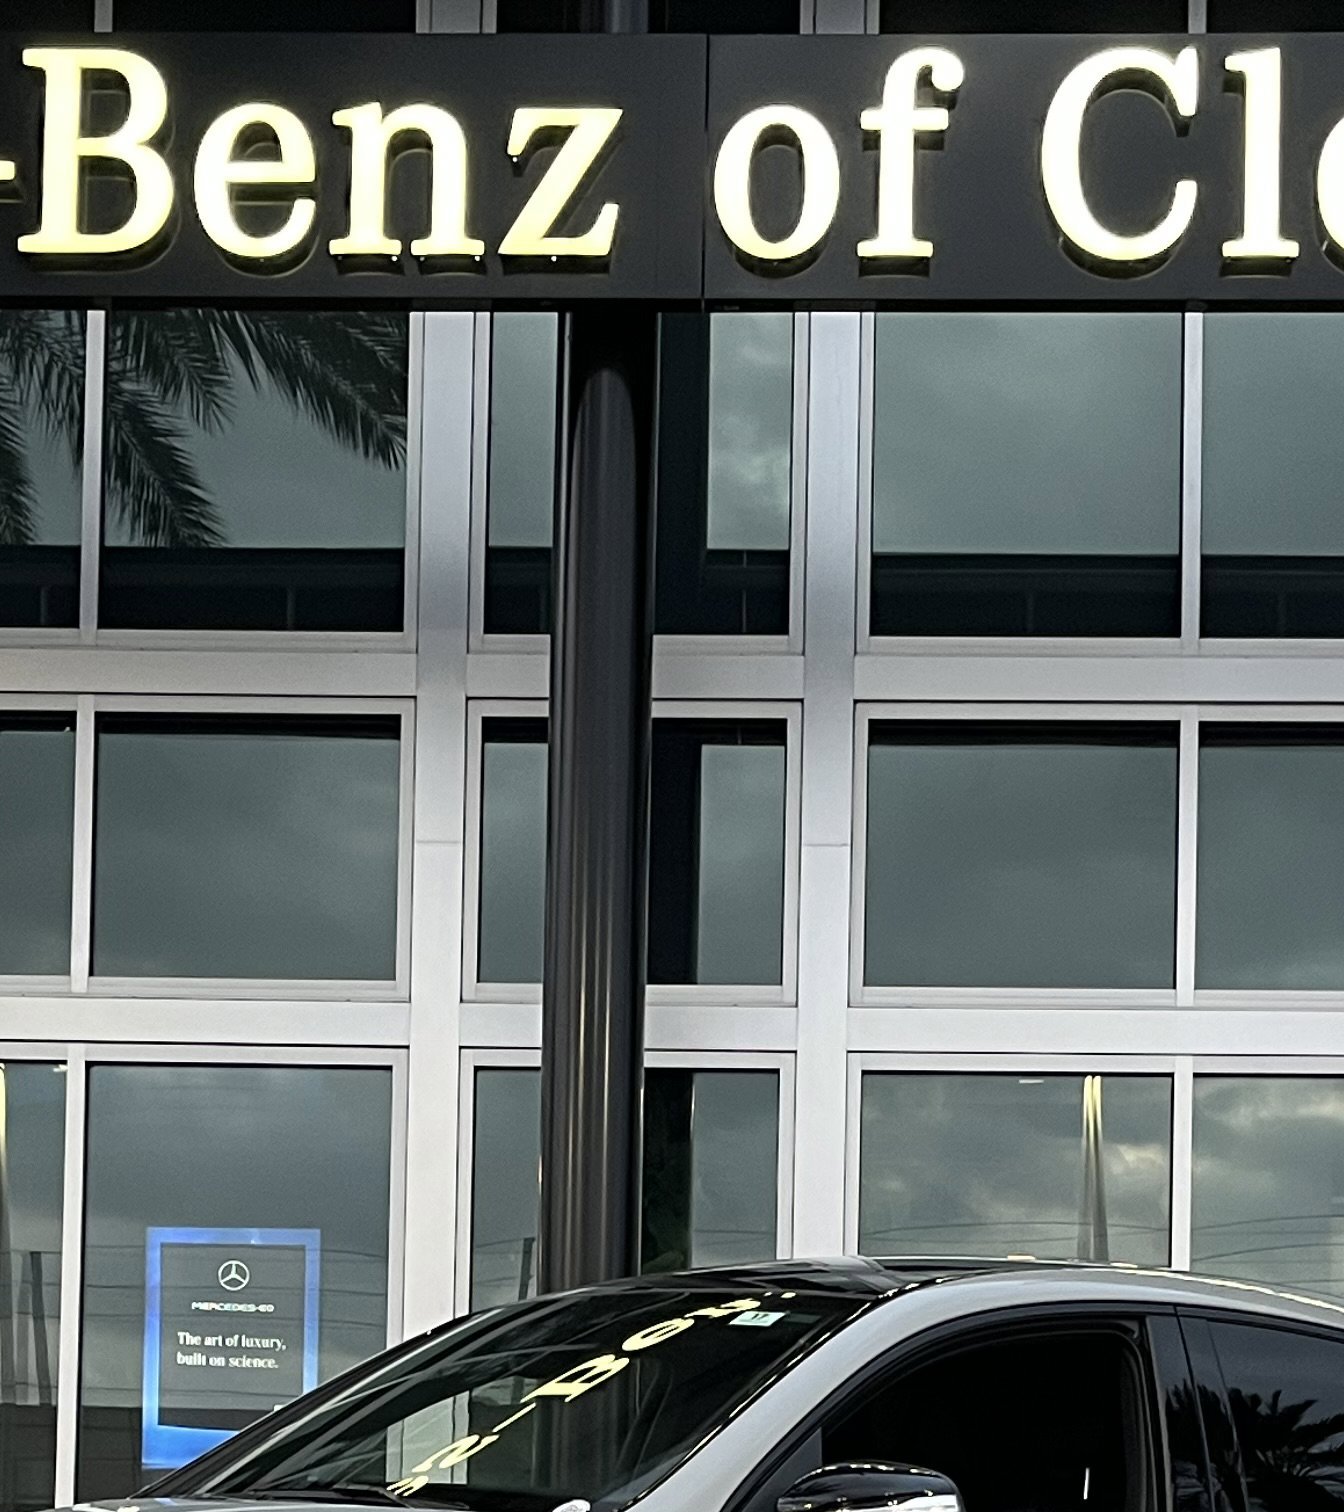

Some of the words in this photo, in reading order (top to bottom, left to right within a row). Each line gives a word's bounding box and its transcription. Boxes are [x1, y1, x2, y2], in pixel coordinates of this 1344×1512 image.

[714, 46, 965, 260] of
[177, 1331, 201, 1345] The
[204, 1335, 223, 1347] art
[225, 1334, 239, 1347] of
[241, 1334, 286, 1351] luxury,
[177, 1352, 207, 1366] built
[209, 1356, 226, 1367] on
[228, 1355, 279, 1368] science.
